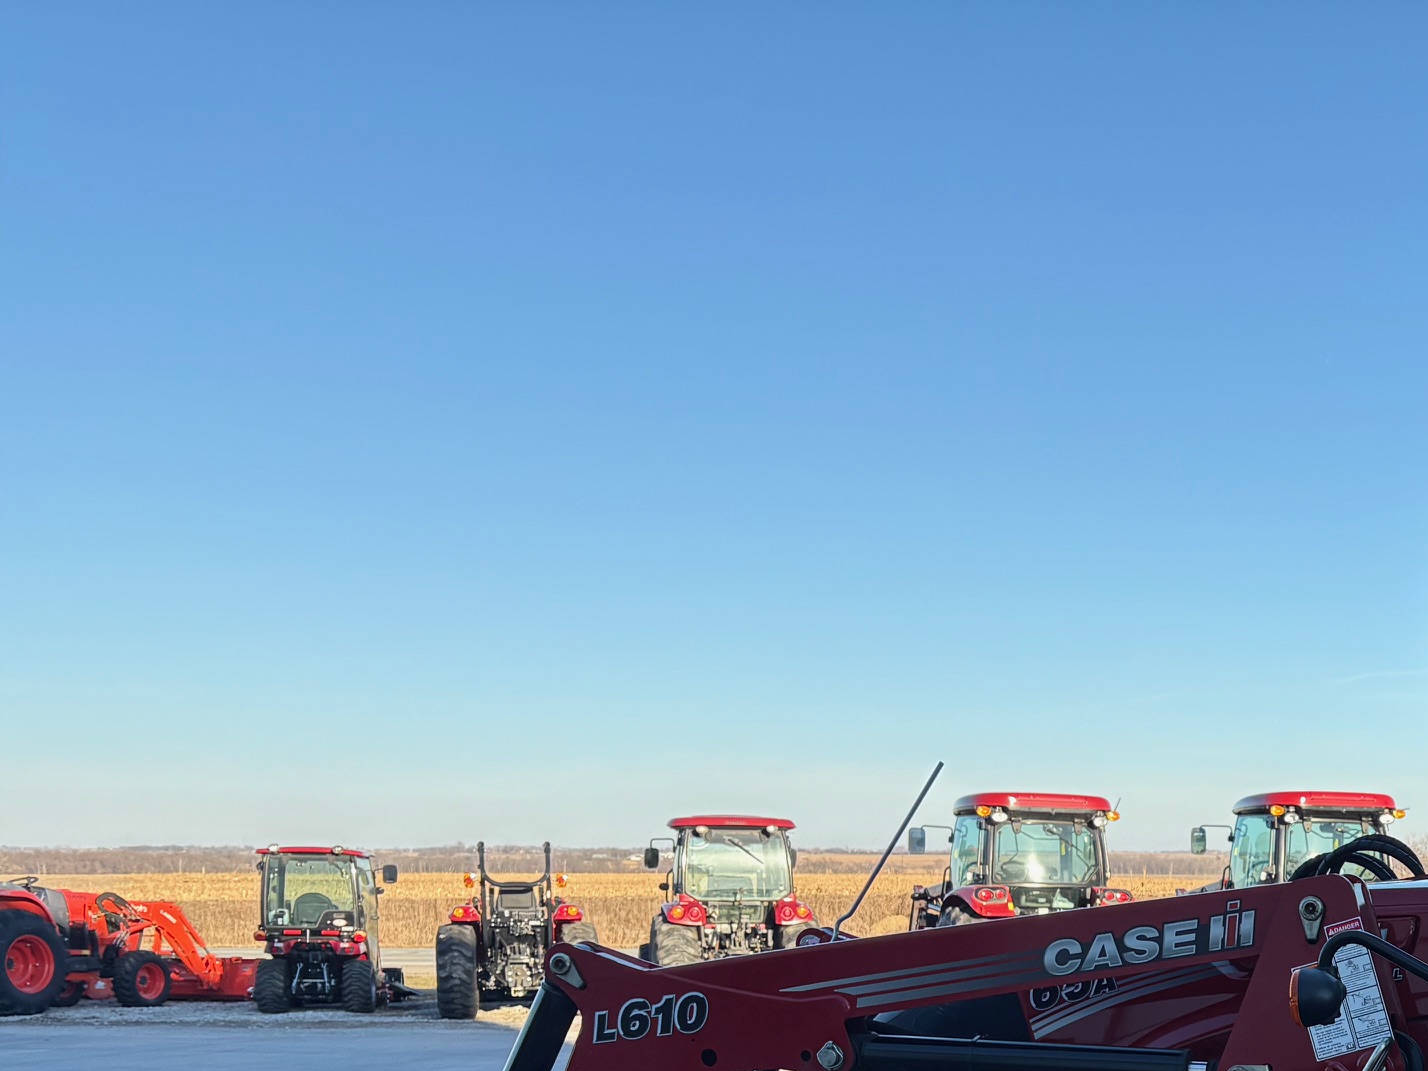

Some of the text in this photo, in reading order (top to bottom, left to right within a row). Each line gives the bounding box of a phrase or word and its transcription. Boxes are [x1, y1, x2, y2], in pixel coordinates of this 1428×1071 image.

[1043, 918, 1199, 976] CASE
[1334, 921, 1360, 935] DANGER
[592, 991, 709, 1044] L610
